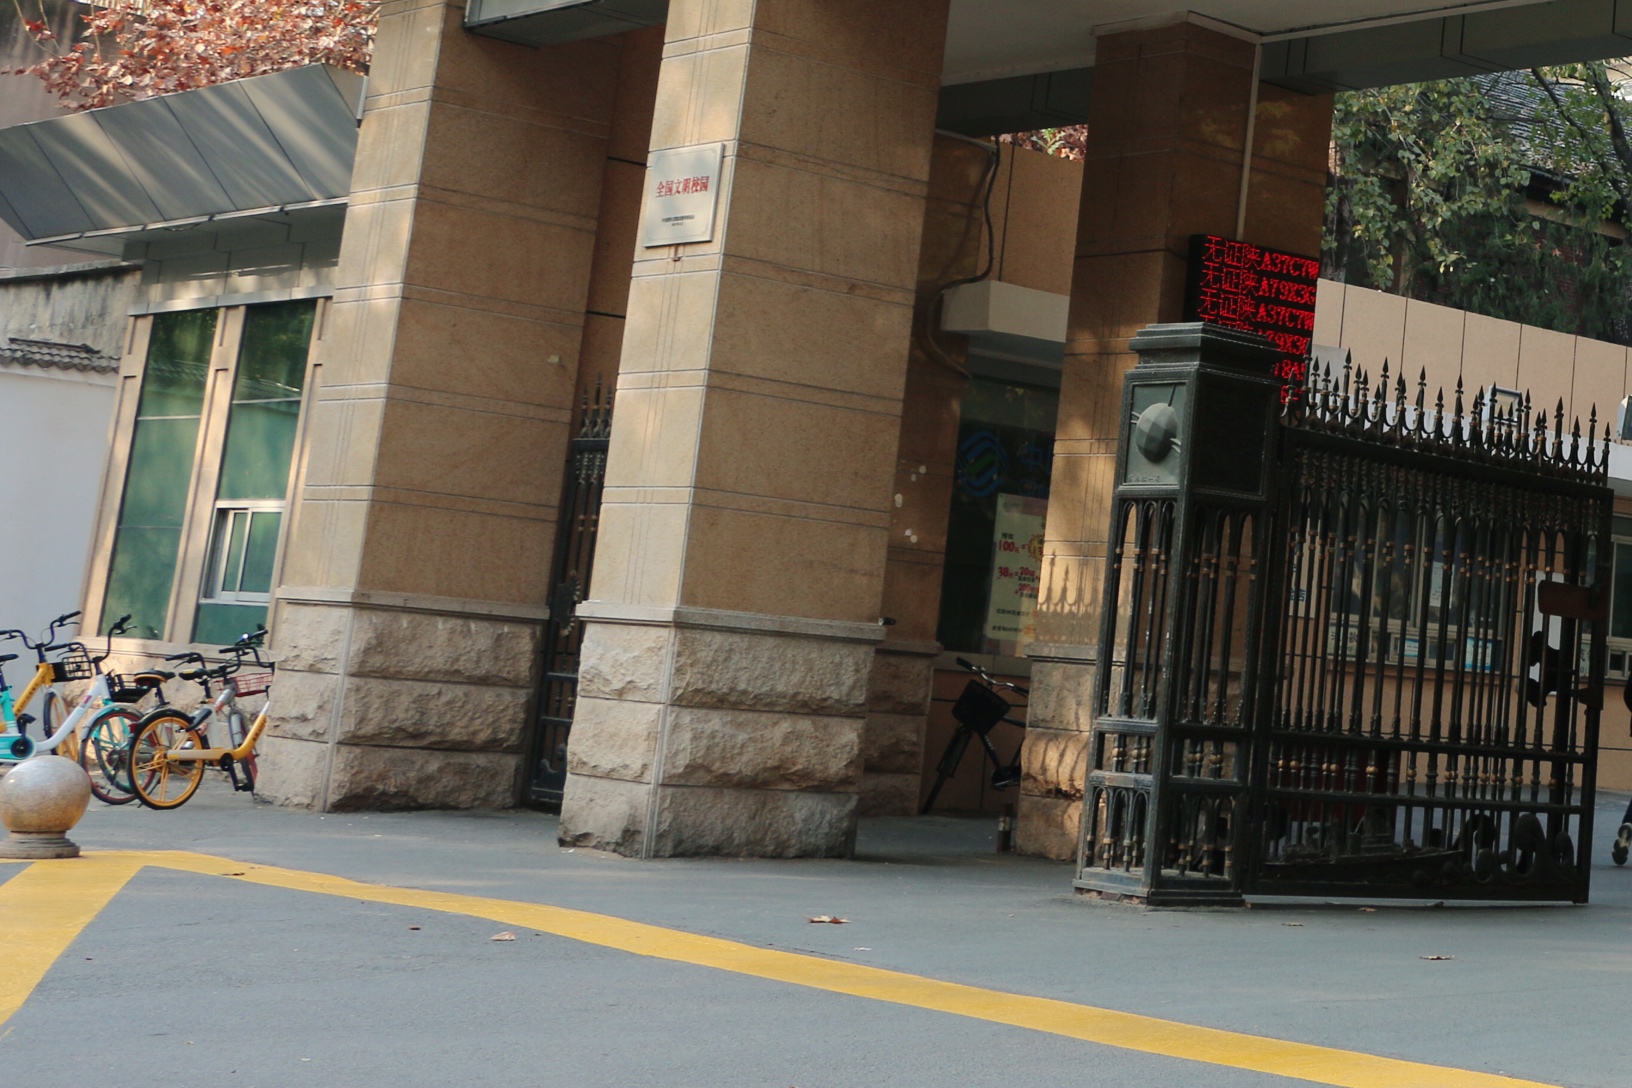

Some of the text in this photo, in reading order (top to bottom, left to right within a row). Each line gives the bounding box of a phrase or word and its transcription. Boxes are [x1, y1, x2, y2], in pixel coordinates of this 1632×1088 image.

[655, 176, 710, 198] 全国文明校园
[1199, 261, 1317, 305] 无证陕A79X3G
